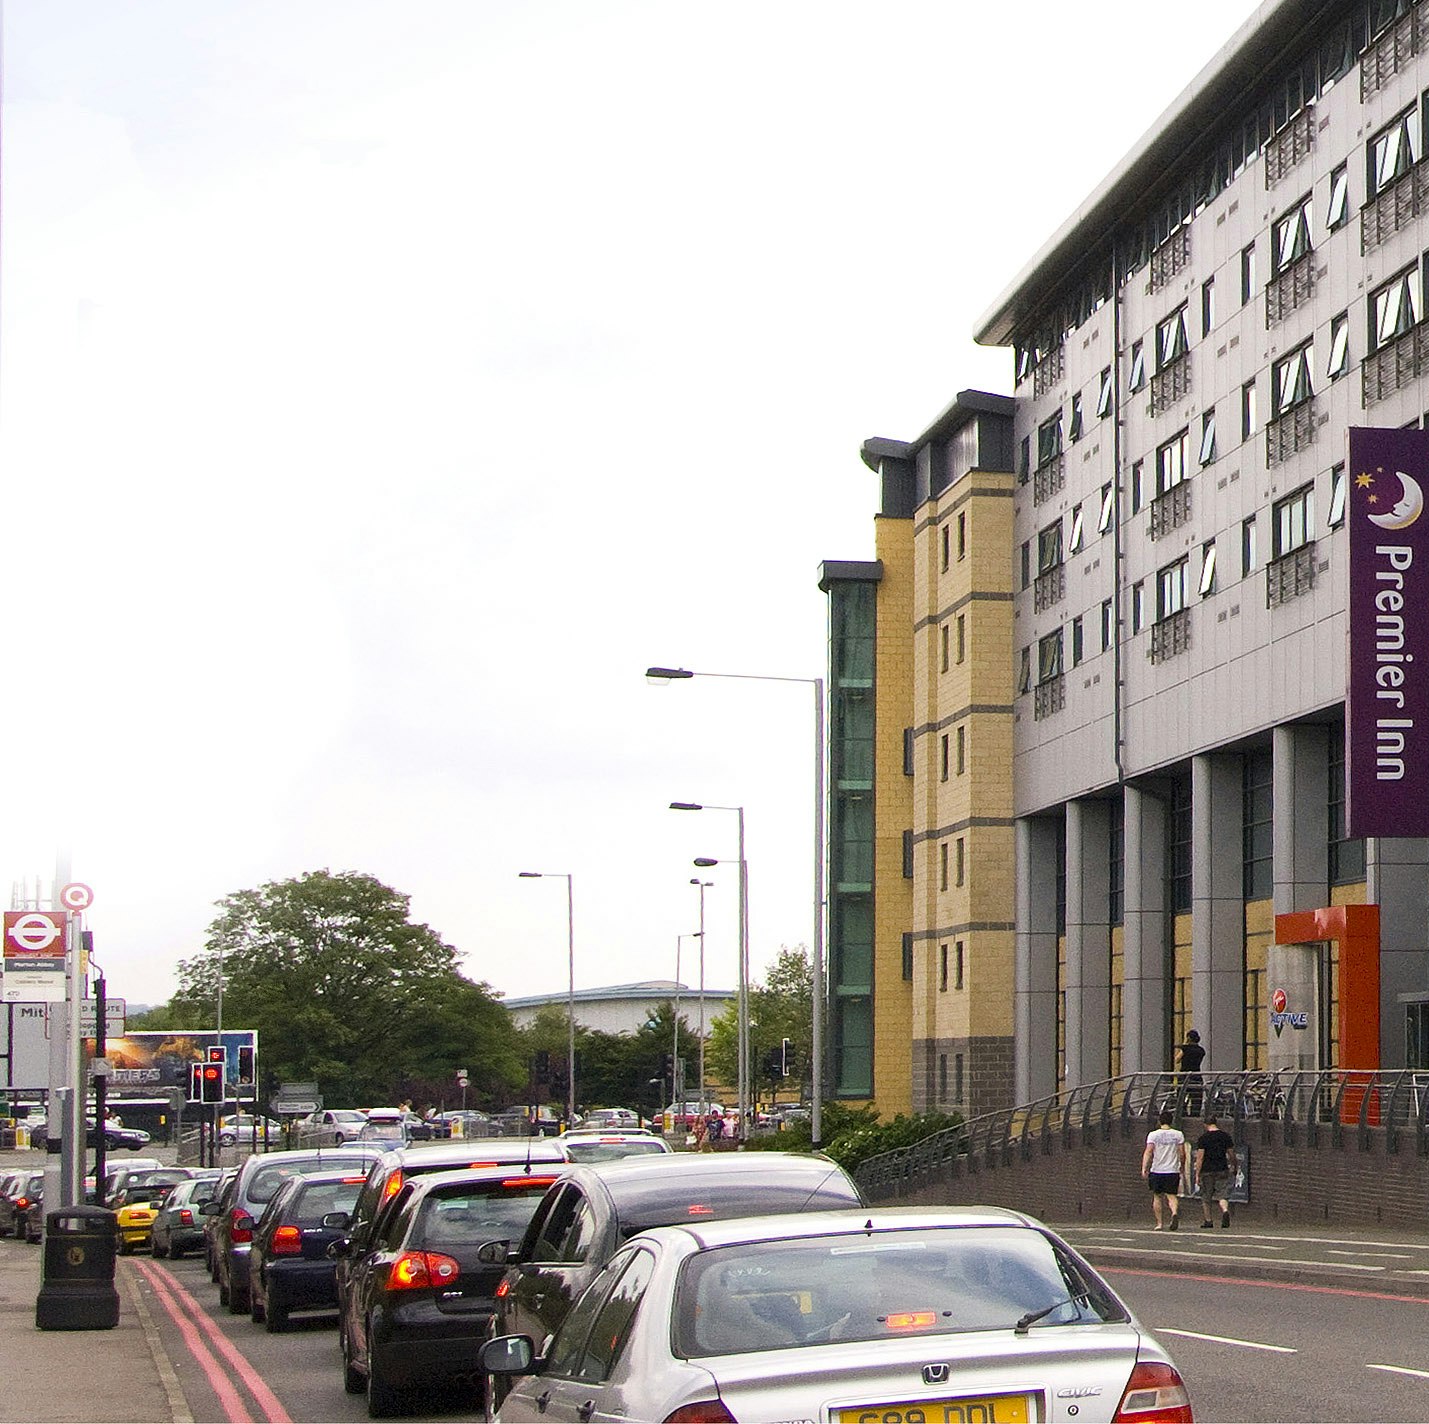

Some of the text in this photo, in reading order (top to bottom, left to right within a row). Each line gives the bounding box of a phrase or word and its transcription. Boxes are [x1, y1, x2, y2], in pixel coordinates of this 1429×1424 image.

[1375, 545, 1414, 780] Premier Inn
[1271, 1012, 1308, 1025] ACTIVE
